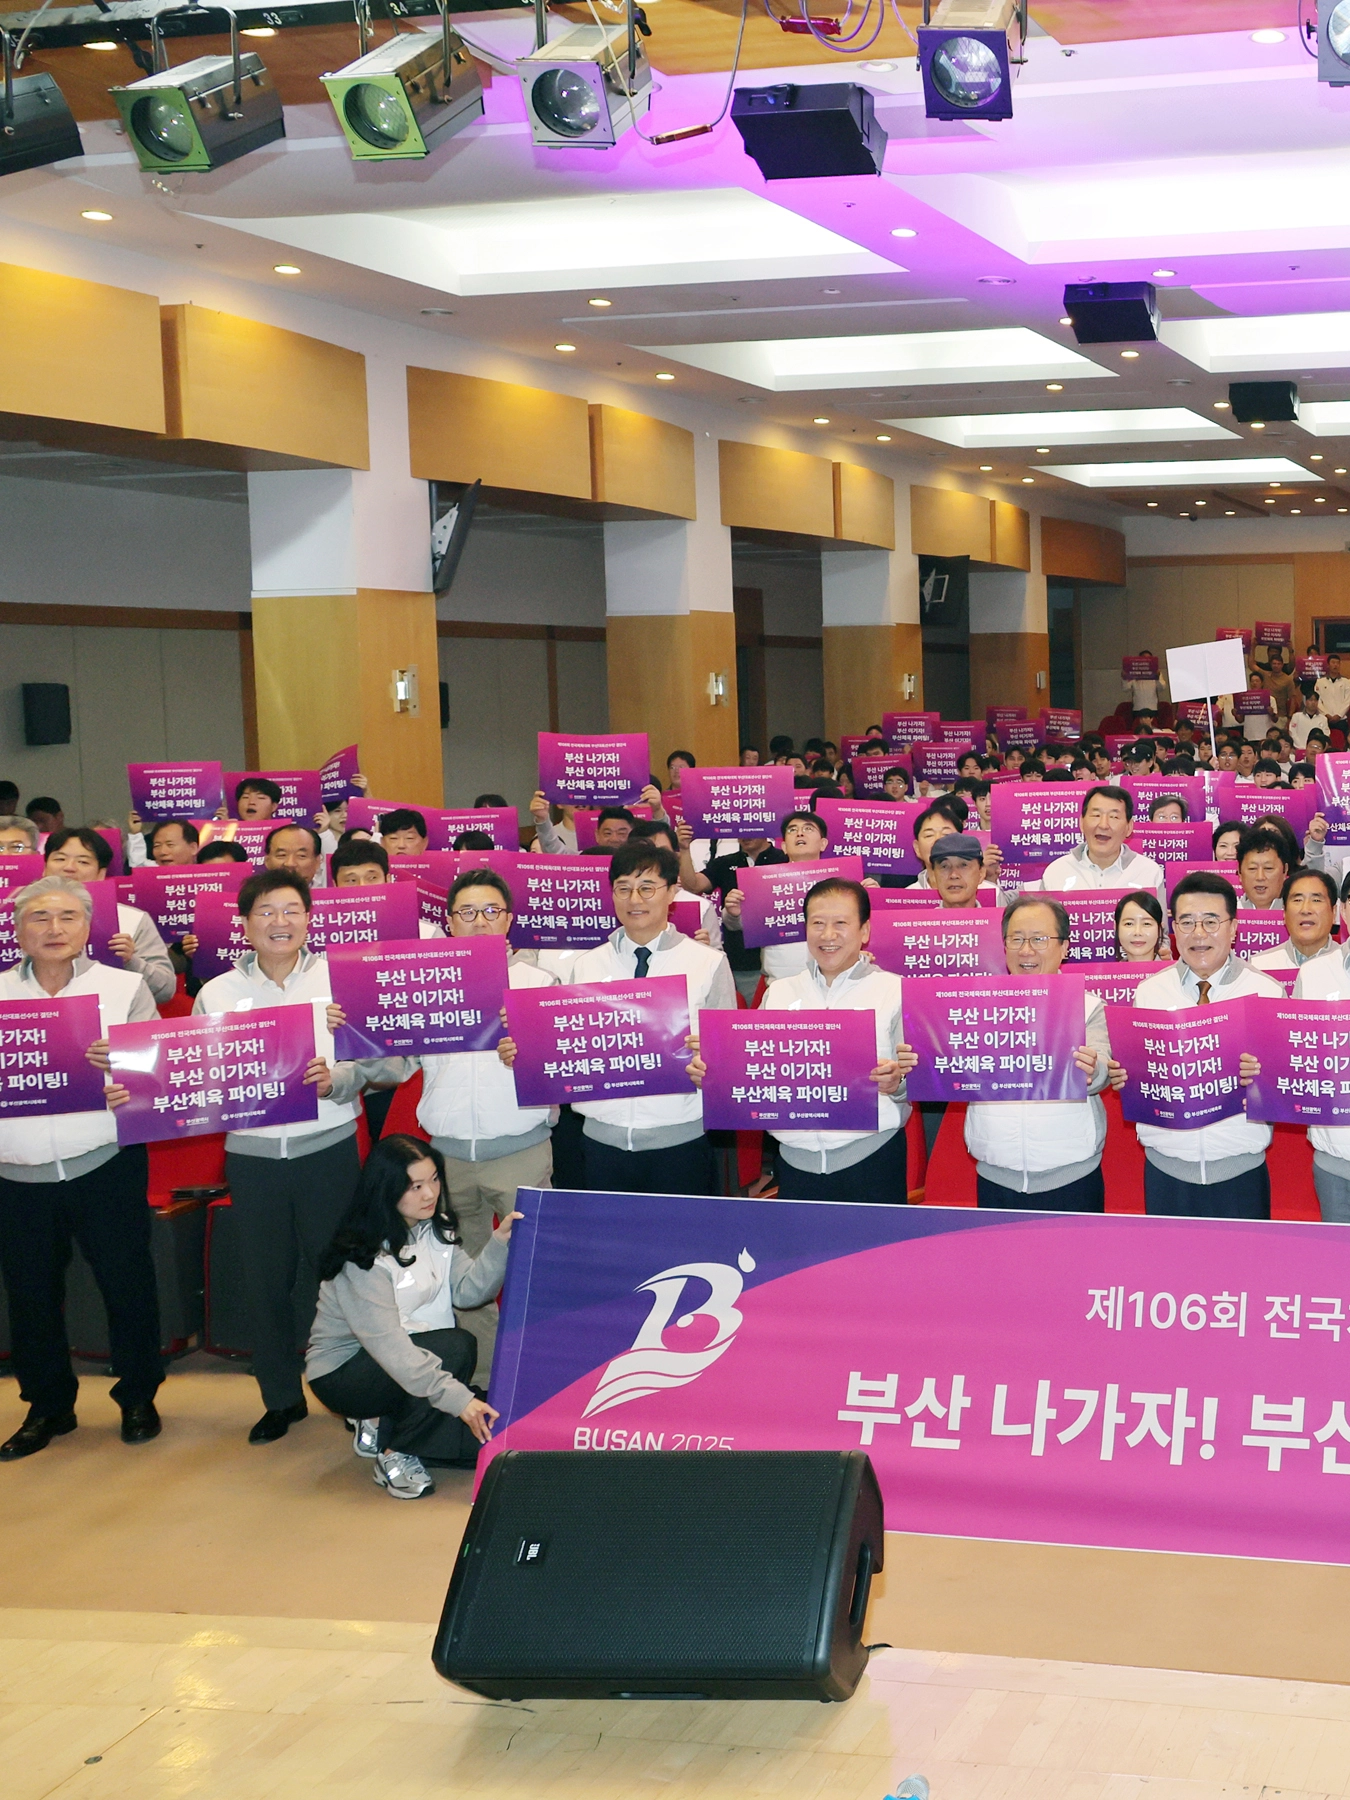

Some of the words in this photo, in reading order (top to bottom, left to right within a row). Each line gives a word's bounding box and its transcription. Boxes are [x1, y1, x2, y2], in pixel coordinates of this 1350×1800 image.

[263, 12, 282, 26] 33
[564, 752, 584, 764] 부산
[586, 752, 620, 764] 나가자!
[565, 766, 585, 777] 부산
[587, 766, 620, 778] 이기자!
[556, 779, 596, 790] 부산체육
[597, 779, 631, 791] 파이팅!
[710, 785, 731, 796] 부산
[732, 784, 765, 796] 나가자!
[711, 799, 731, 810] 부산
[733, 798, 766, 810] 이기자!
[702, 812, 742, 824] 부산체육
[743, 812, 776, 823] 파이팅!
[527, 878, 552, 892] 부산
[556, 879, 600, 893] 나가자!
[528, 896, 554, 910] 부산
[557, 897, 602, 911] 이기자!
[516, 915, 568, 929] 부산체육
[571, 916, 616, 930] 파이팅!
[375, 969, 407, 987] 부산
[410, 966, 462, 985] 나가자!
[378, 991, 409, 1009] 부산
[412, 988, 464, 1007] 이기자!
[365, 1013, 426, 1032] 부산체육
[429, 1009, 482, 1028] 파이팅!
[553, 1013, 585, 1032] 부산
[588, 1010, 641, 1029] 나가자!
[948, 1007, 980, 1026] 부산
[984, 1006, 1036, 1025] 나가자!
[556, 1036, 588, 1055] 부산
[591, 1032, 644, 1052] 이기자!
[744, 1040, 775, 1057] 부산
[779, 1039, 831, 1057] 나가자!
[948, 1031, 980, 1050] 부산
[984, 1030, 1036, 1049] 이기자!
[1144, 1038, 1166, 1056] 부산
[1168, 1034, 1220, 1055] 나가자!
[1288, 1030, 1319, 1049] 부산
[167, 1045, 202, 1065] 부산
[207, 1038, 265, 1059] 나가자!
[543, 1058, 606, 1079] 부산체육
[608, 1052, 662, 1072] 파이팅!
[745, 1063, 777, 1080] 부산
[780, 1062, 832, 1080] 이기자!
[934, 1055, 996, 1074] 부산체육
[999, 1054, 1053, 1073] 파이팅!
[1148, 1058, 1168, 1077] 부산
[1172, 1057, 1222, 1078] 이기자!
[1289, 1054, 1320, 1073] 부산
[7, 1072, 68, 1091] 파이팅!
[169, 1068, 204, 1088] 부산
[209, 1061, 267, 1082] 이기자!
[731, 1085, 793, 1103] 부산체육
[796, 1085, 848, 1103] 파이팅!
[1140, 1083, 1185, 1101] 부산체육
[1189, 1076, 1238, 1099] 파이팅!
[1276, 1076, 1336, 1098] 부산체육
[153, 1089, 224, 1114] 부산체육
[228, 1081, 285, 1103] 파이팅!
[1086, 1286, 1247, 1337] 제106회
[838, 1372, 971, 1449] 부산
[991, 1380, 1218, 1465] 나가자!
[573, 1427, 664, 1450] BUSAN
[526, 1543, 540, 1560] JBL
